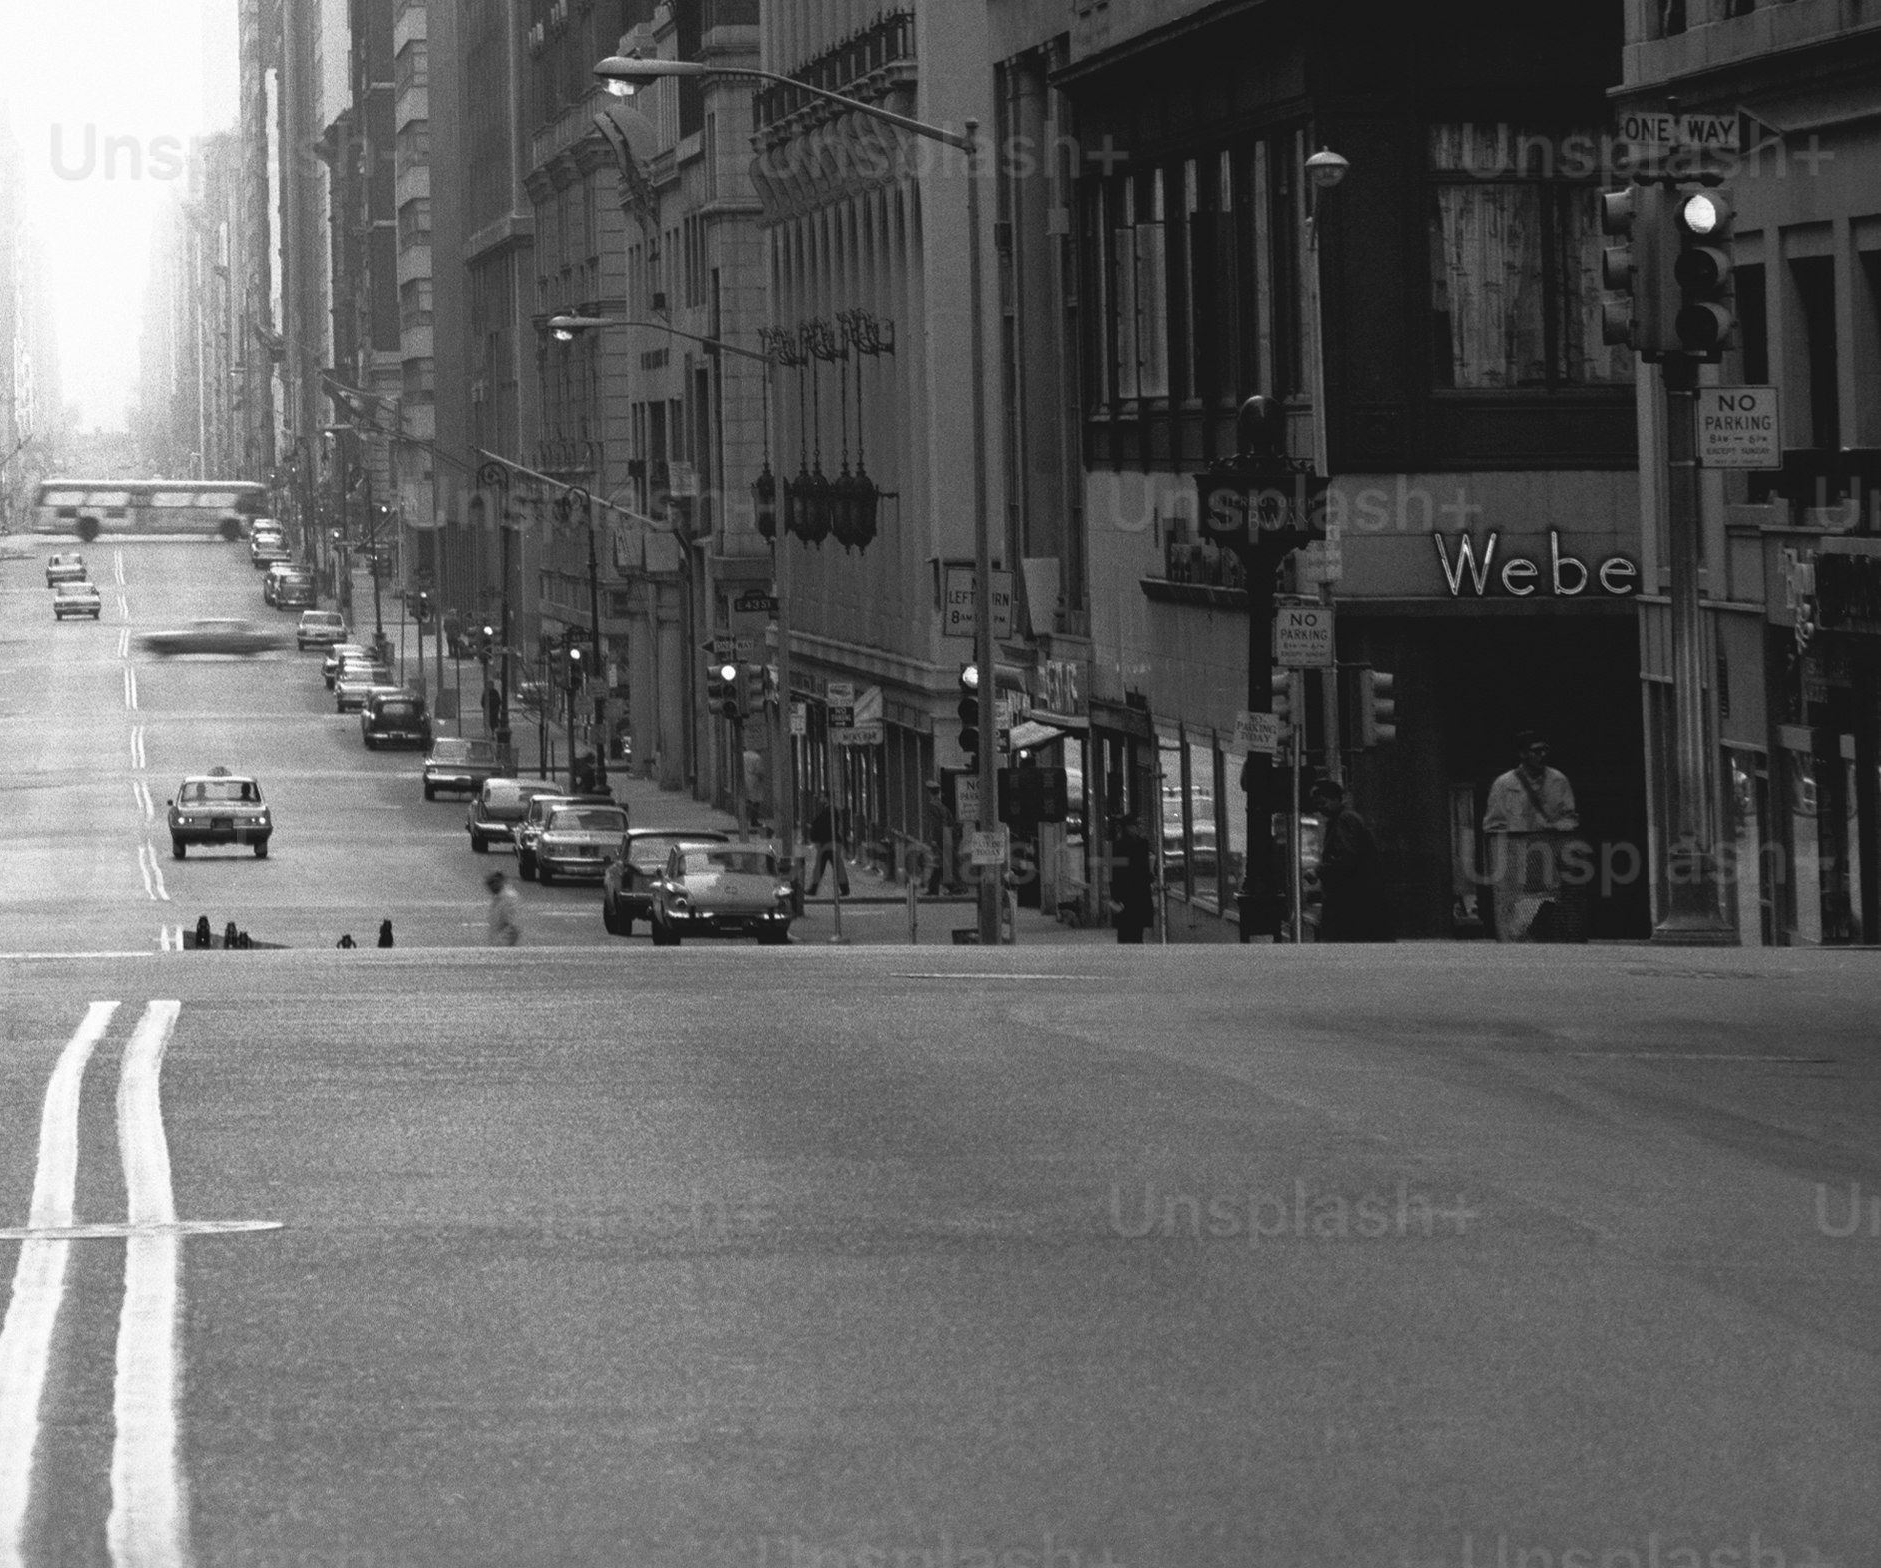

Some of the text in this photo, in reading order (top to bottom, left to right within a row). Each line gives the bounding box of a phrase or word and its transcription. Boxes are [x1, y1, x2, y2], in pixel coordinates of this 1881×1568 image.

[1624, 117, 1734, 144] ONE WAY
[1718, 394, 1756, 412] NO
[1705, 416, 1771, 431] PARKING
[1434, 531, 1638, 596] Webe
[949, 591, 976, 605] LEFT
[1290, 613, 1318, 627] NO
[1280, 628, 1328, 641] PARKING
